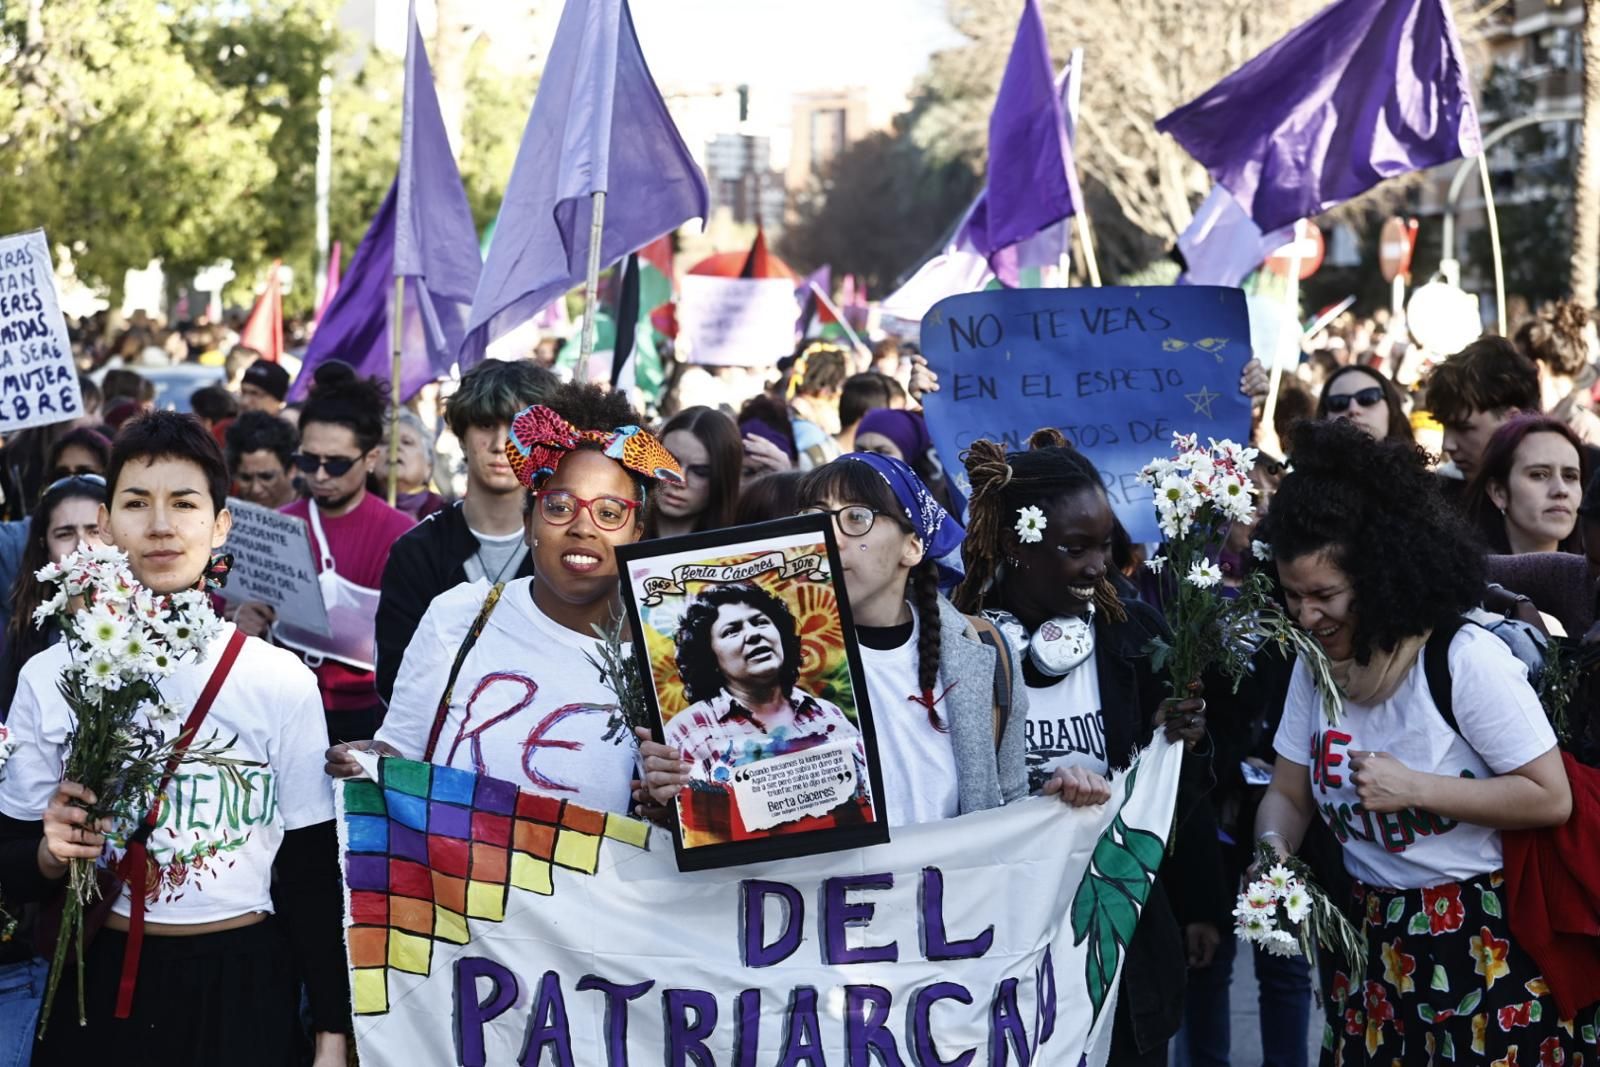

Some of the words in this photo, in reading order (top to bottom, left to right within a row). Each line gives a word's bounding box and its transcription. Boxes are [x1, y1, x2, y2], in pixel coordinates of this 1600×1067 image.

[948, 313, 1003, 352] NO
[1015, 308, 1071, 341] TE
[1080, 306, 1171, 335] VEAS
[3, 365, 72, 397] MUJER
[953, 373, 998, 401] EN
[1022, 373, 1064, 399] EL
[1076, 367, 1184, 398] ESPEJO
[1059, 423, 1120, 449] JOS
[1127, 418, 1170, 443] DE
[681, 565, 718, 581] Berta
[721, 557, 775, 581] Cáceres
[792, 557, 814, 572] 2016
[767, 795, 797, 813] Berta
[796, 786, 836, 805] Cáceres
[738, 866, 996, 968] DEL
